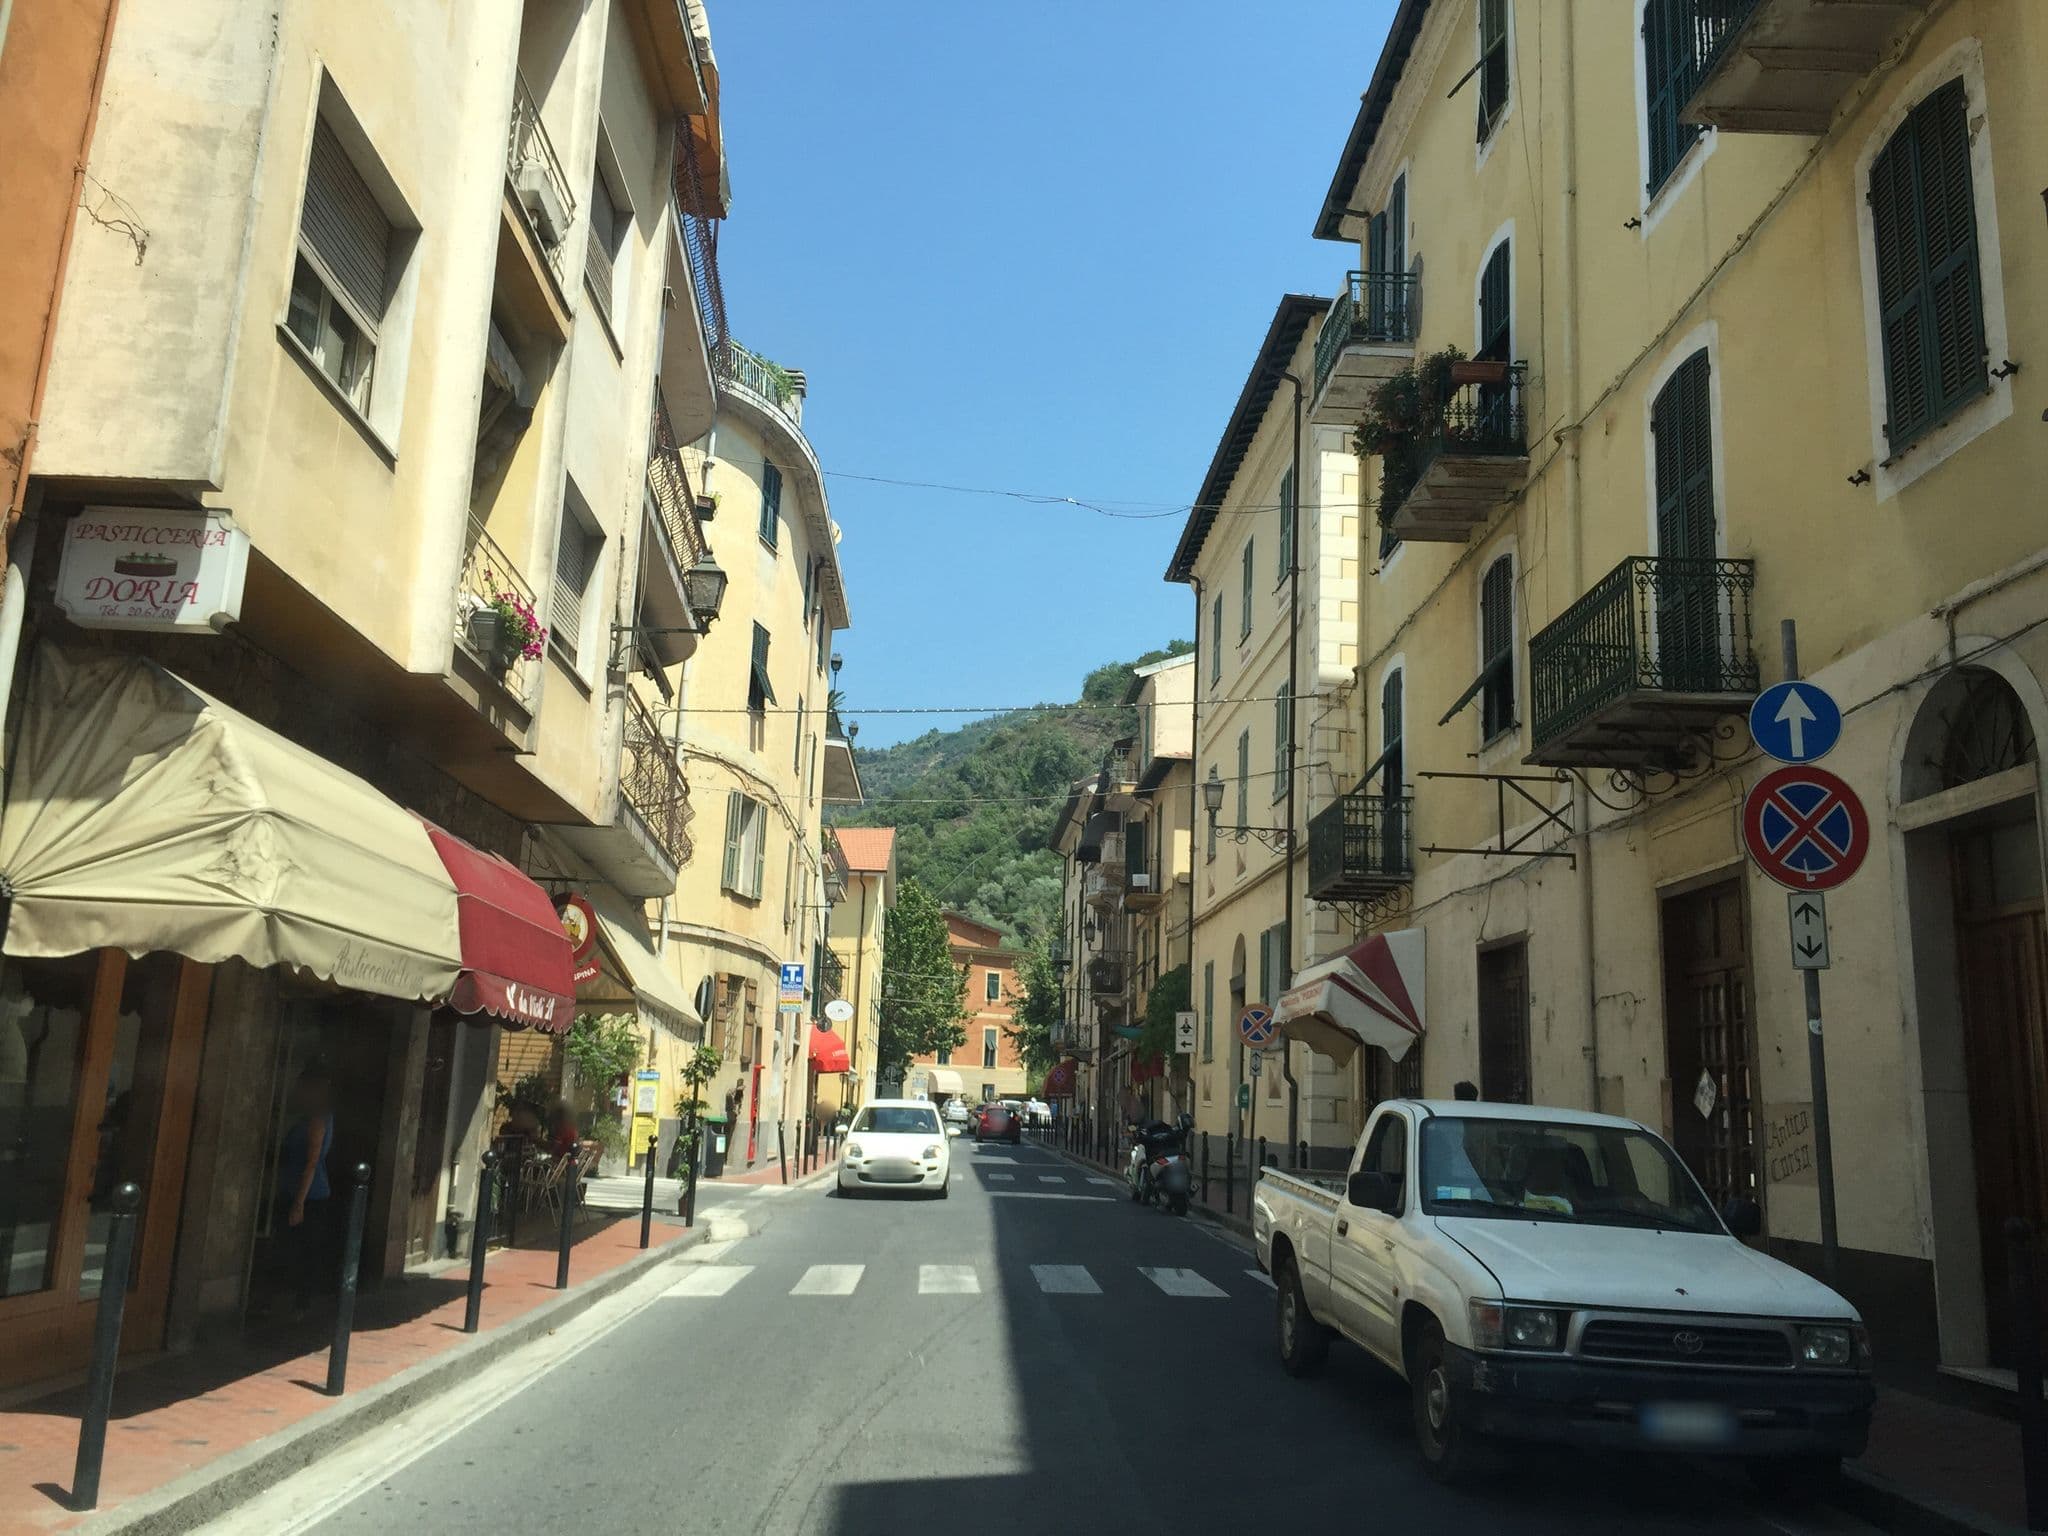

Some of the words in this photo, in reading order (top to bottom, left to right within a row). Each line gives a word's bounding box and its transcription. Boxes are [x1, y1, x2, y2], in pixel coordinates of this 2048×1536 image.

[76, 524, 227, 548] PASTICCERIA
[85, 576, 199, 608] DORIA
[1771, 1145, 1812, 1182] Corsa
